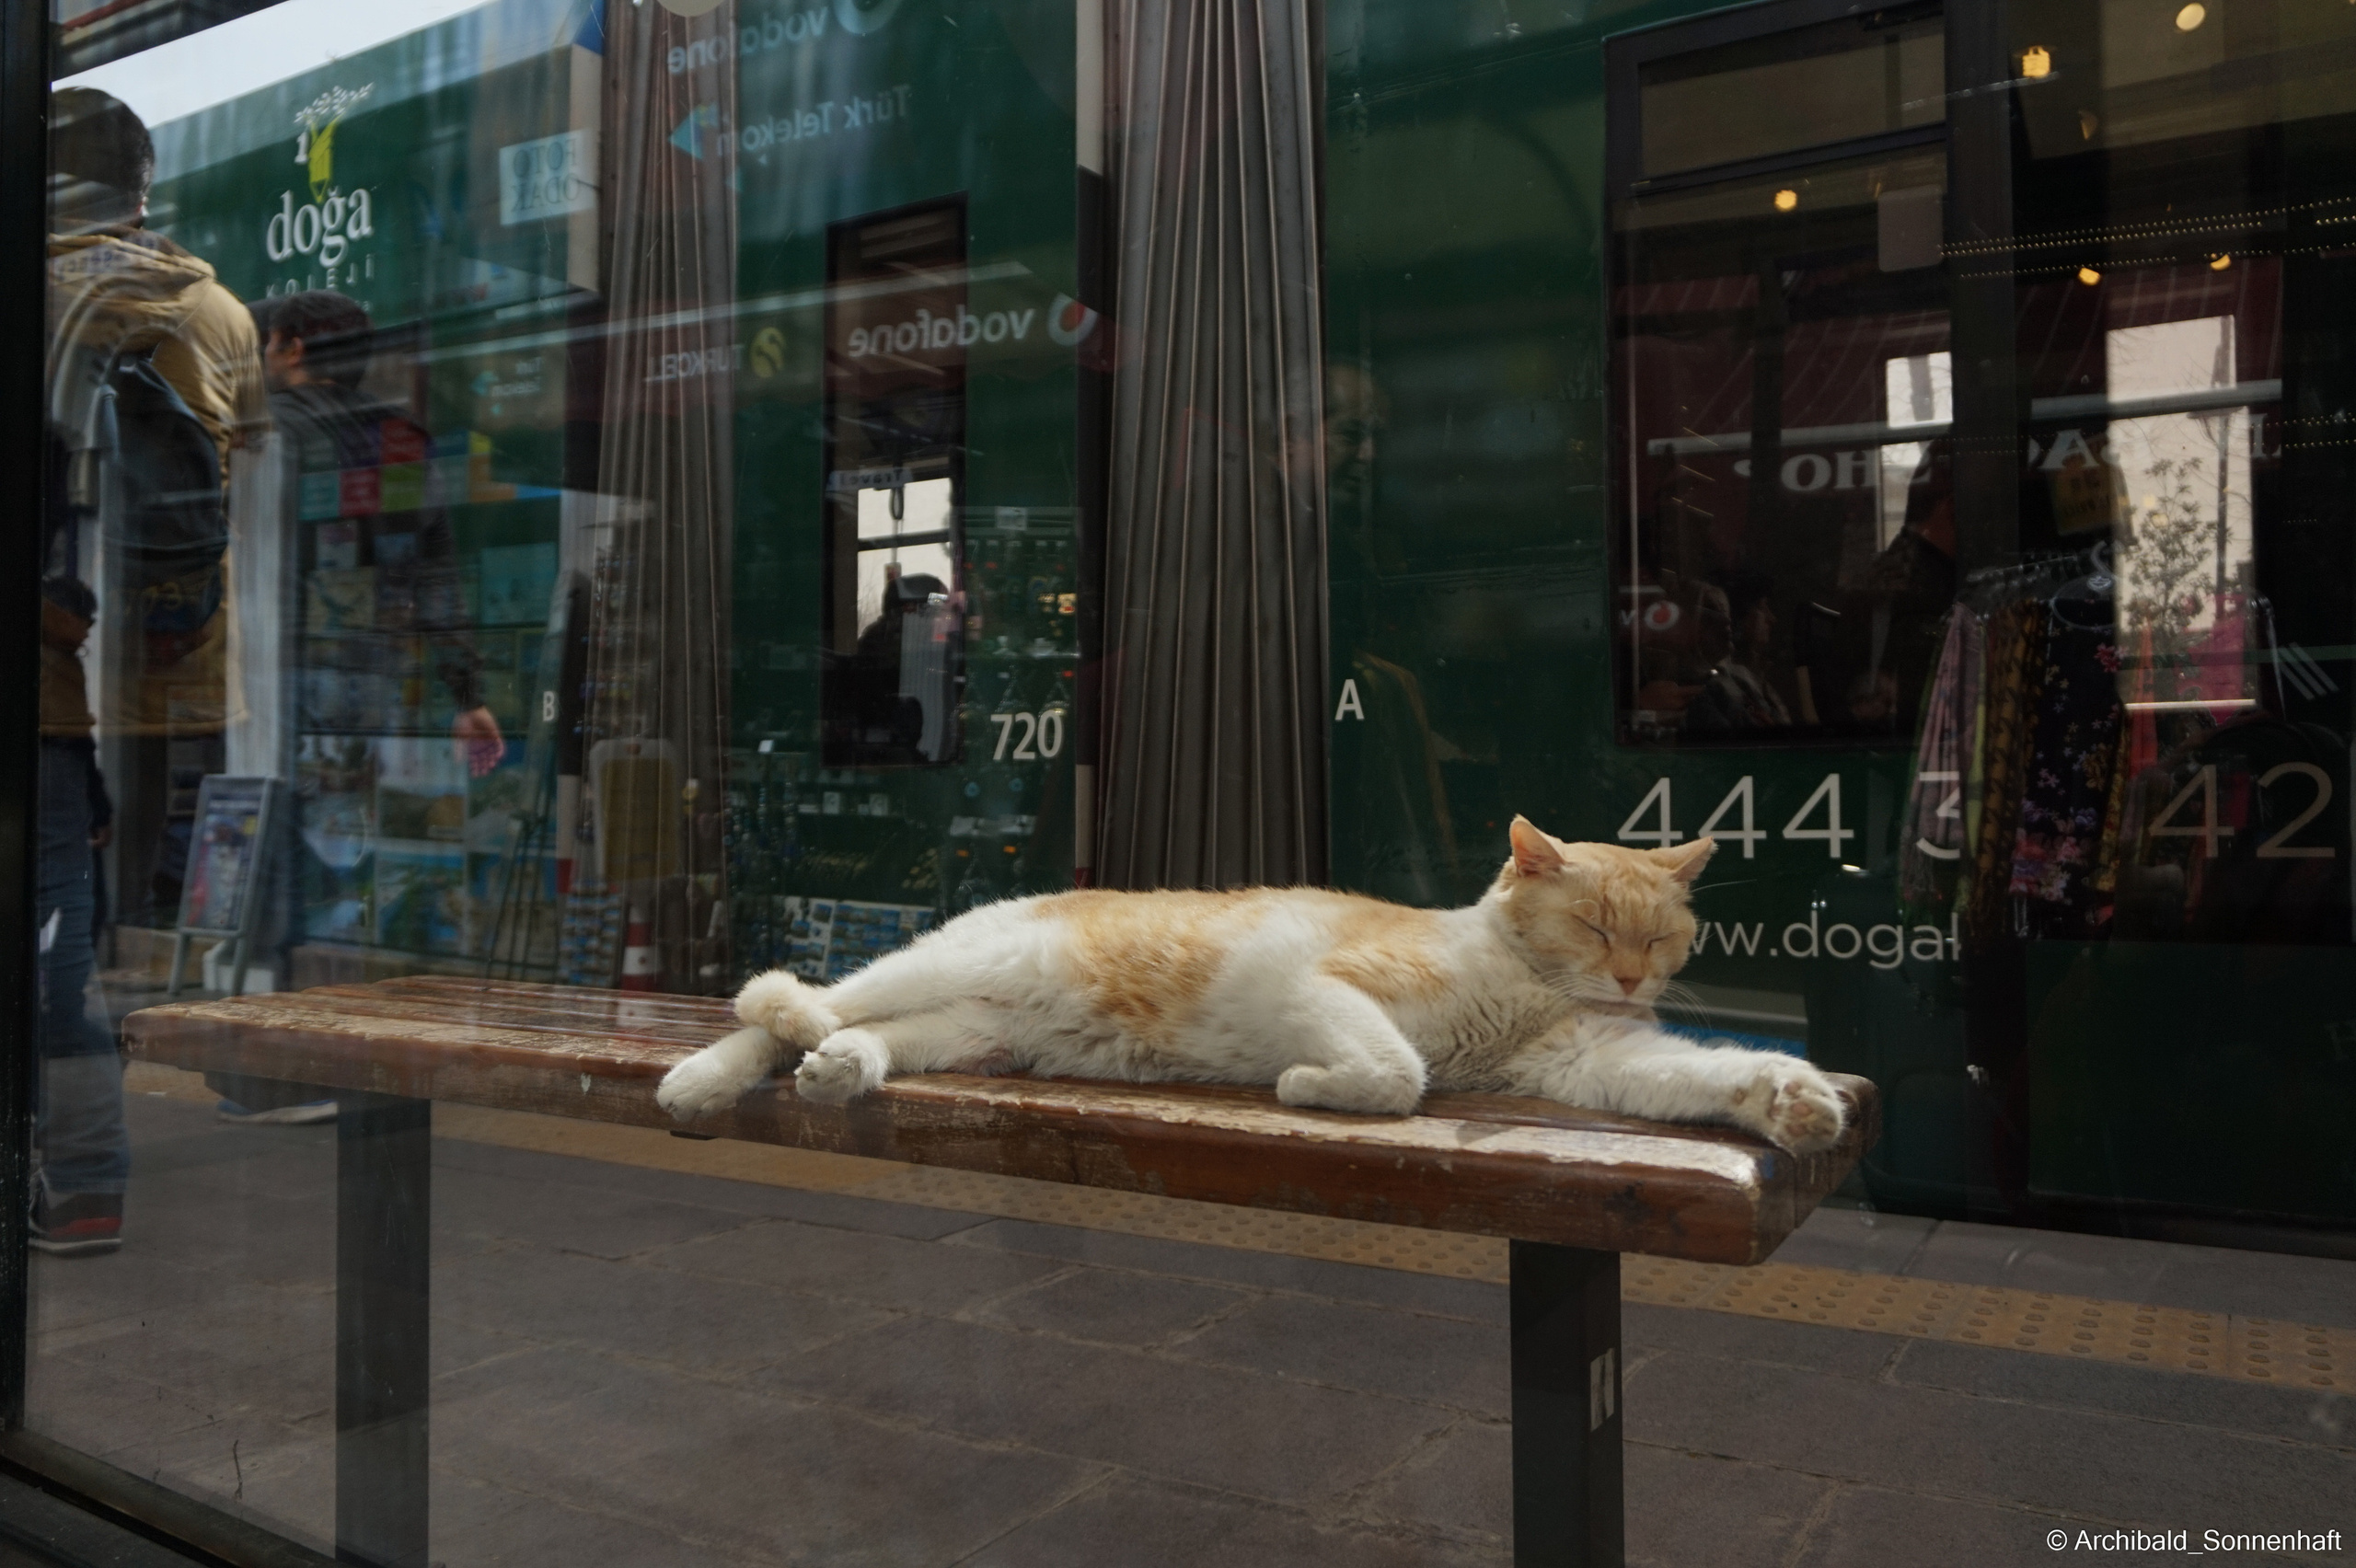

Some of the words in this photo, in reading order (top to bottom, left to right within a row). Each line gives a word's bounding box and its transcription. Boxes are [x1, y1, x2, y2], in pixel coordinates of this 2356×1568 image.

[266, 185, 375, 269] doğa
[543, 690, 555, 721] B
[1334, 678, 1365, 721] A
[990, 709, 1063, 761] 720
[1616, 772, 1855, 859] 444
[2147, 760, 2337, 859] 42
